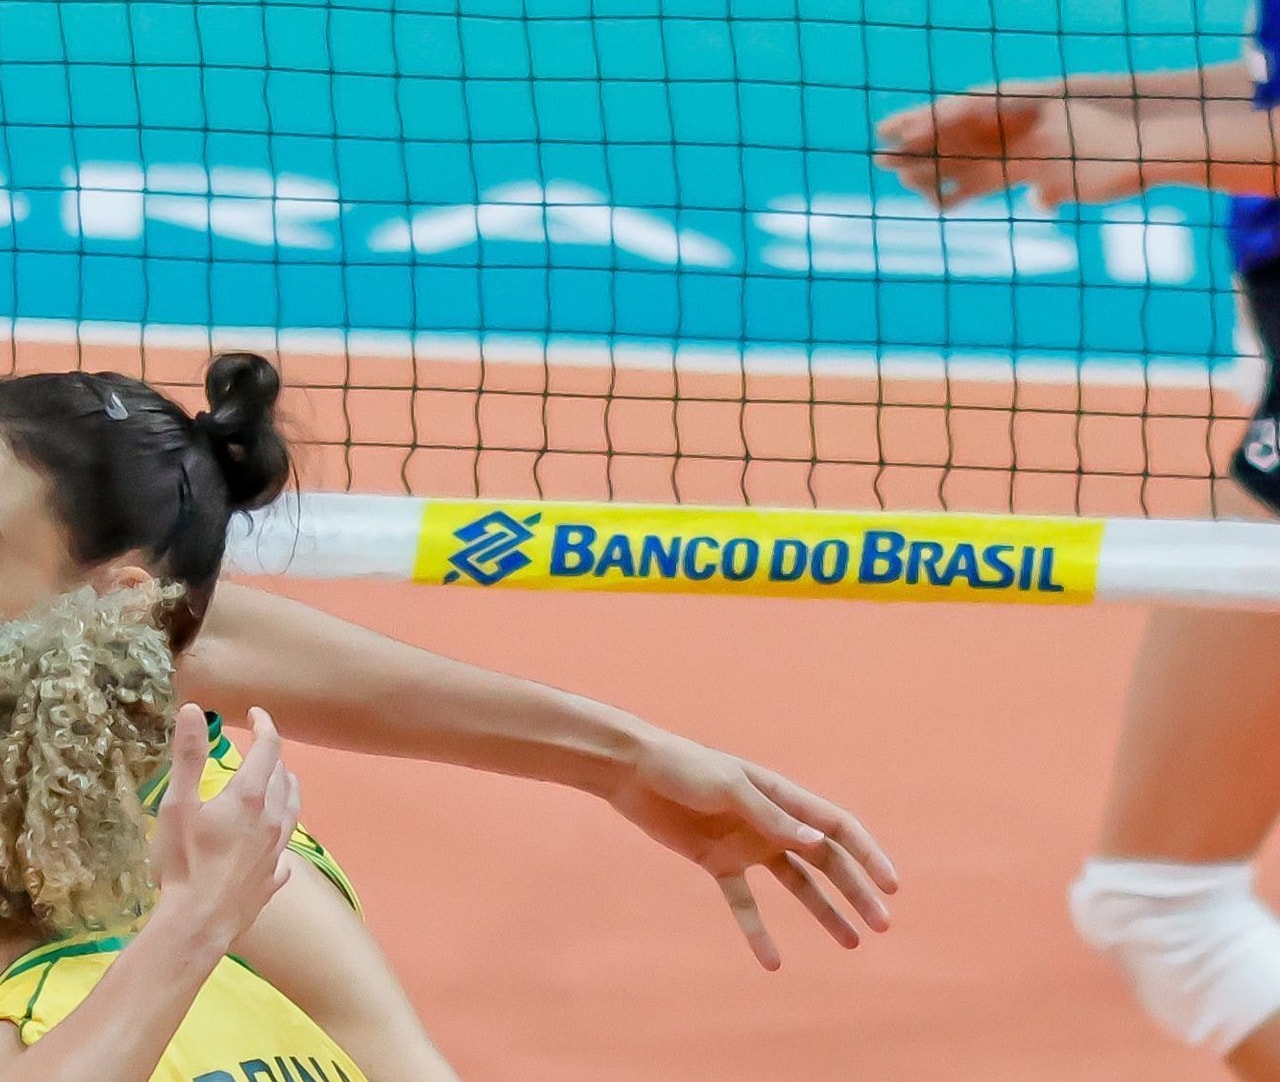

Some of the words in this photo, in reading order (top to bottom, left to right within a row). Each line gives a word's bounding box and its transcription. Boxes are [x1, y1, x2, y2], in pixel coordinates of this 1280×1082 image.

[549, 523, 760, 582] BANCO
[769, 538, 850, 586] DO
[858, 530, 1065, 593] BRASIL
